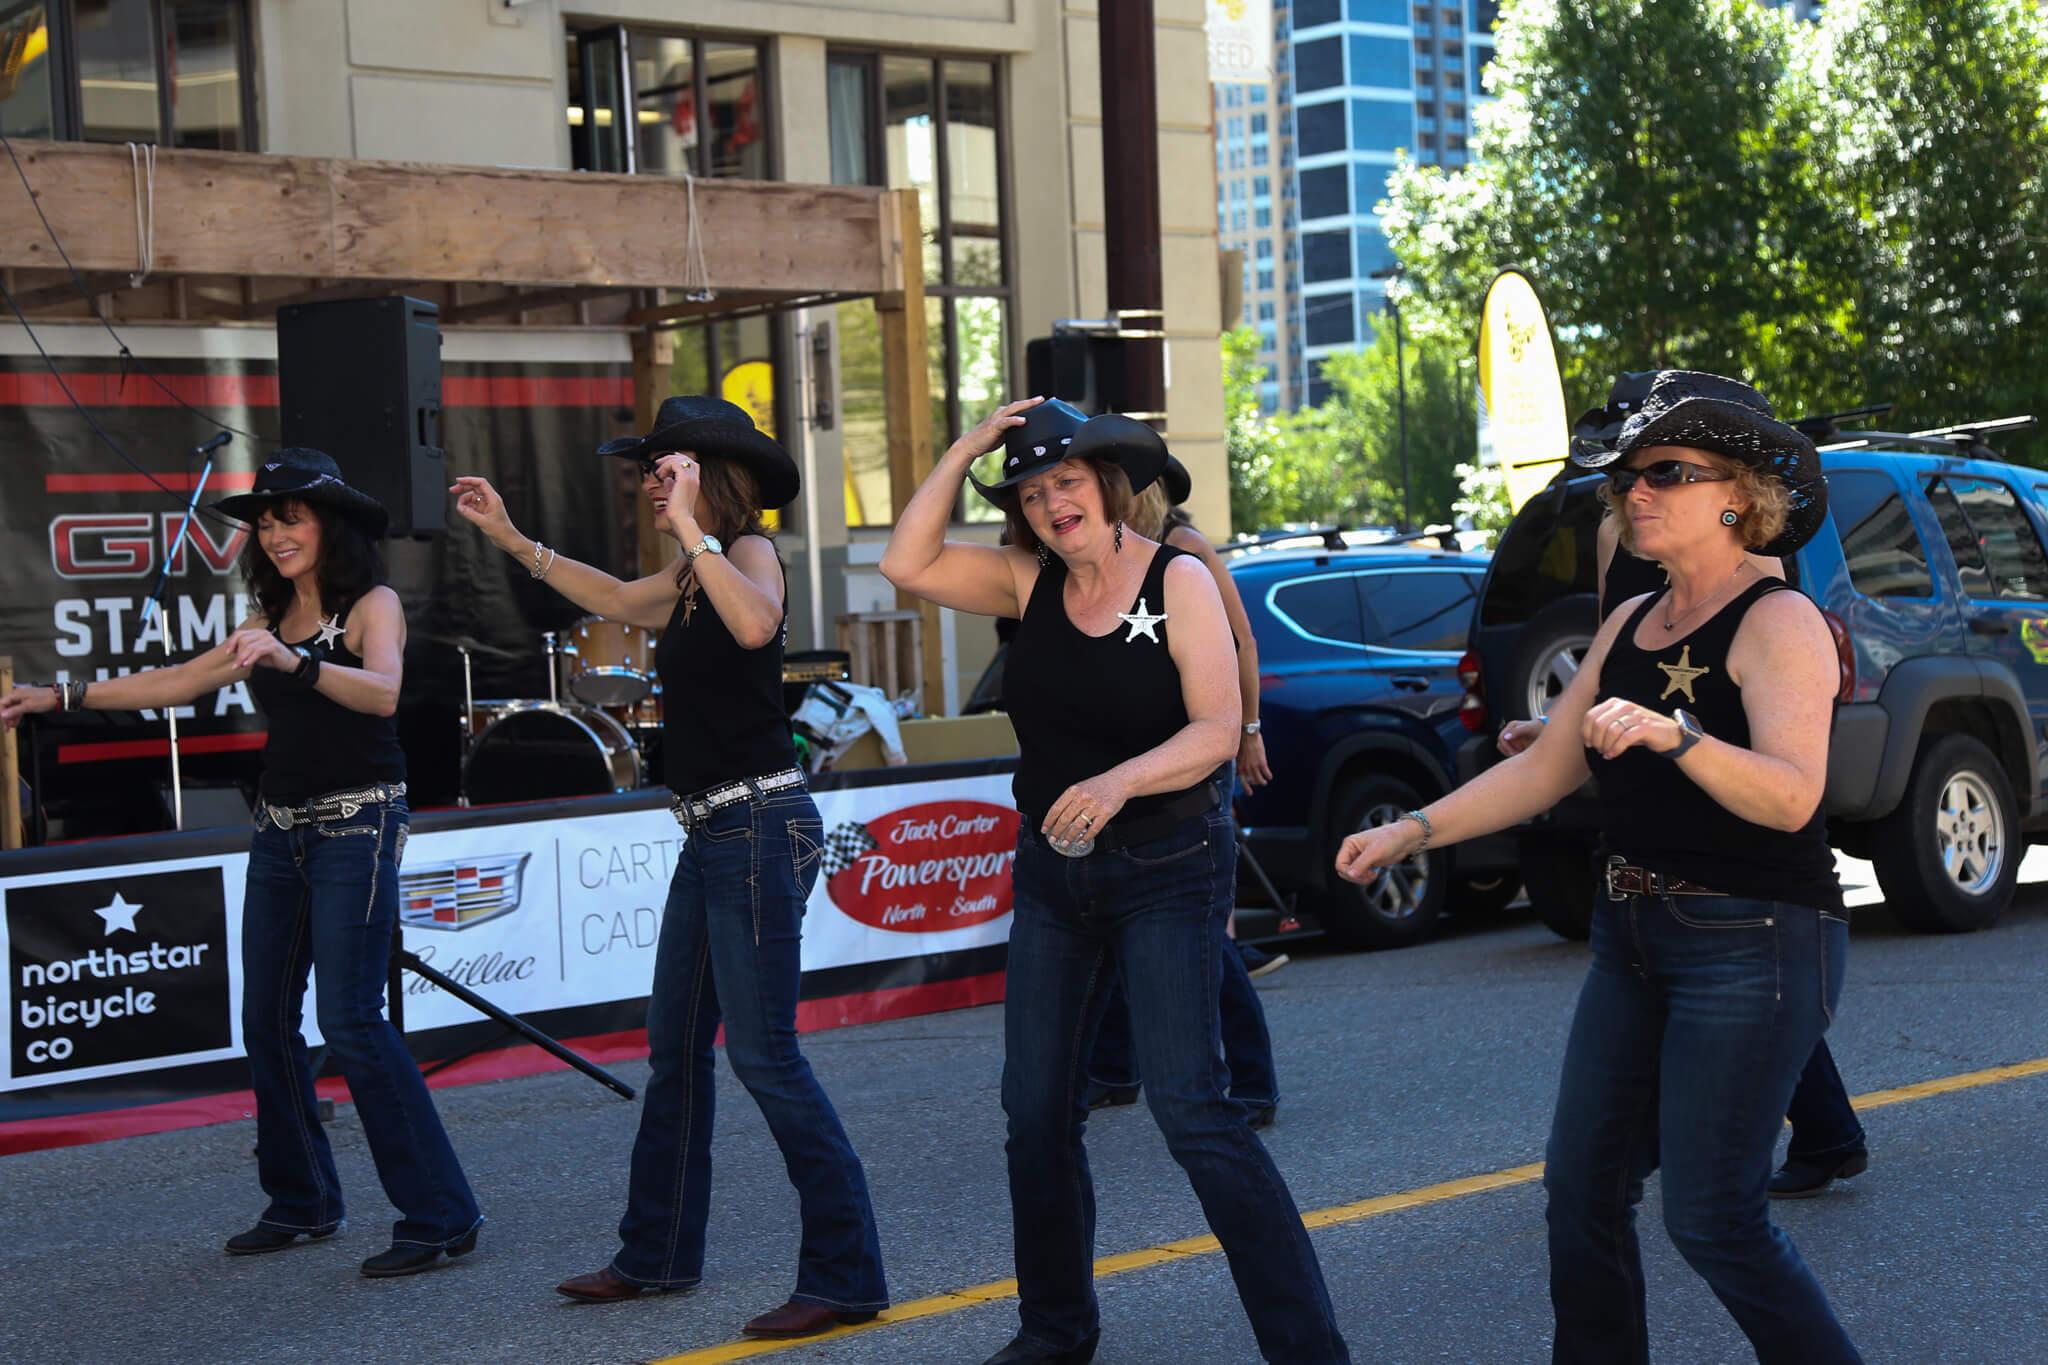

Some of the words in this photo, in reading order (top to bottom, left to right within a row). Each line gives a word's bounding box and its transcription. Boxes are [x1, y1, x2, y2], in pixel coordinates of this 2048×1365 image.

[890, 818, 938, 844] Jack
[940, 813, 999, 839] Carter
[578, 837, 687, 889] CART
[581, 906, 664, 956] CAD
[882, 902, 926, 926] North
[949, 895, 998, 917] South
[21, 941, 209, 988] northstar
[20, 987, 157, 1029] bicycle
[25, 1036, 74, 1063] co
